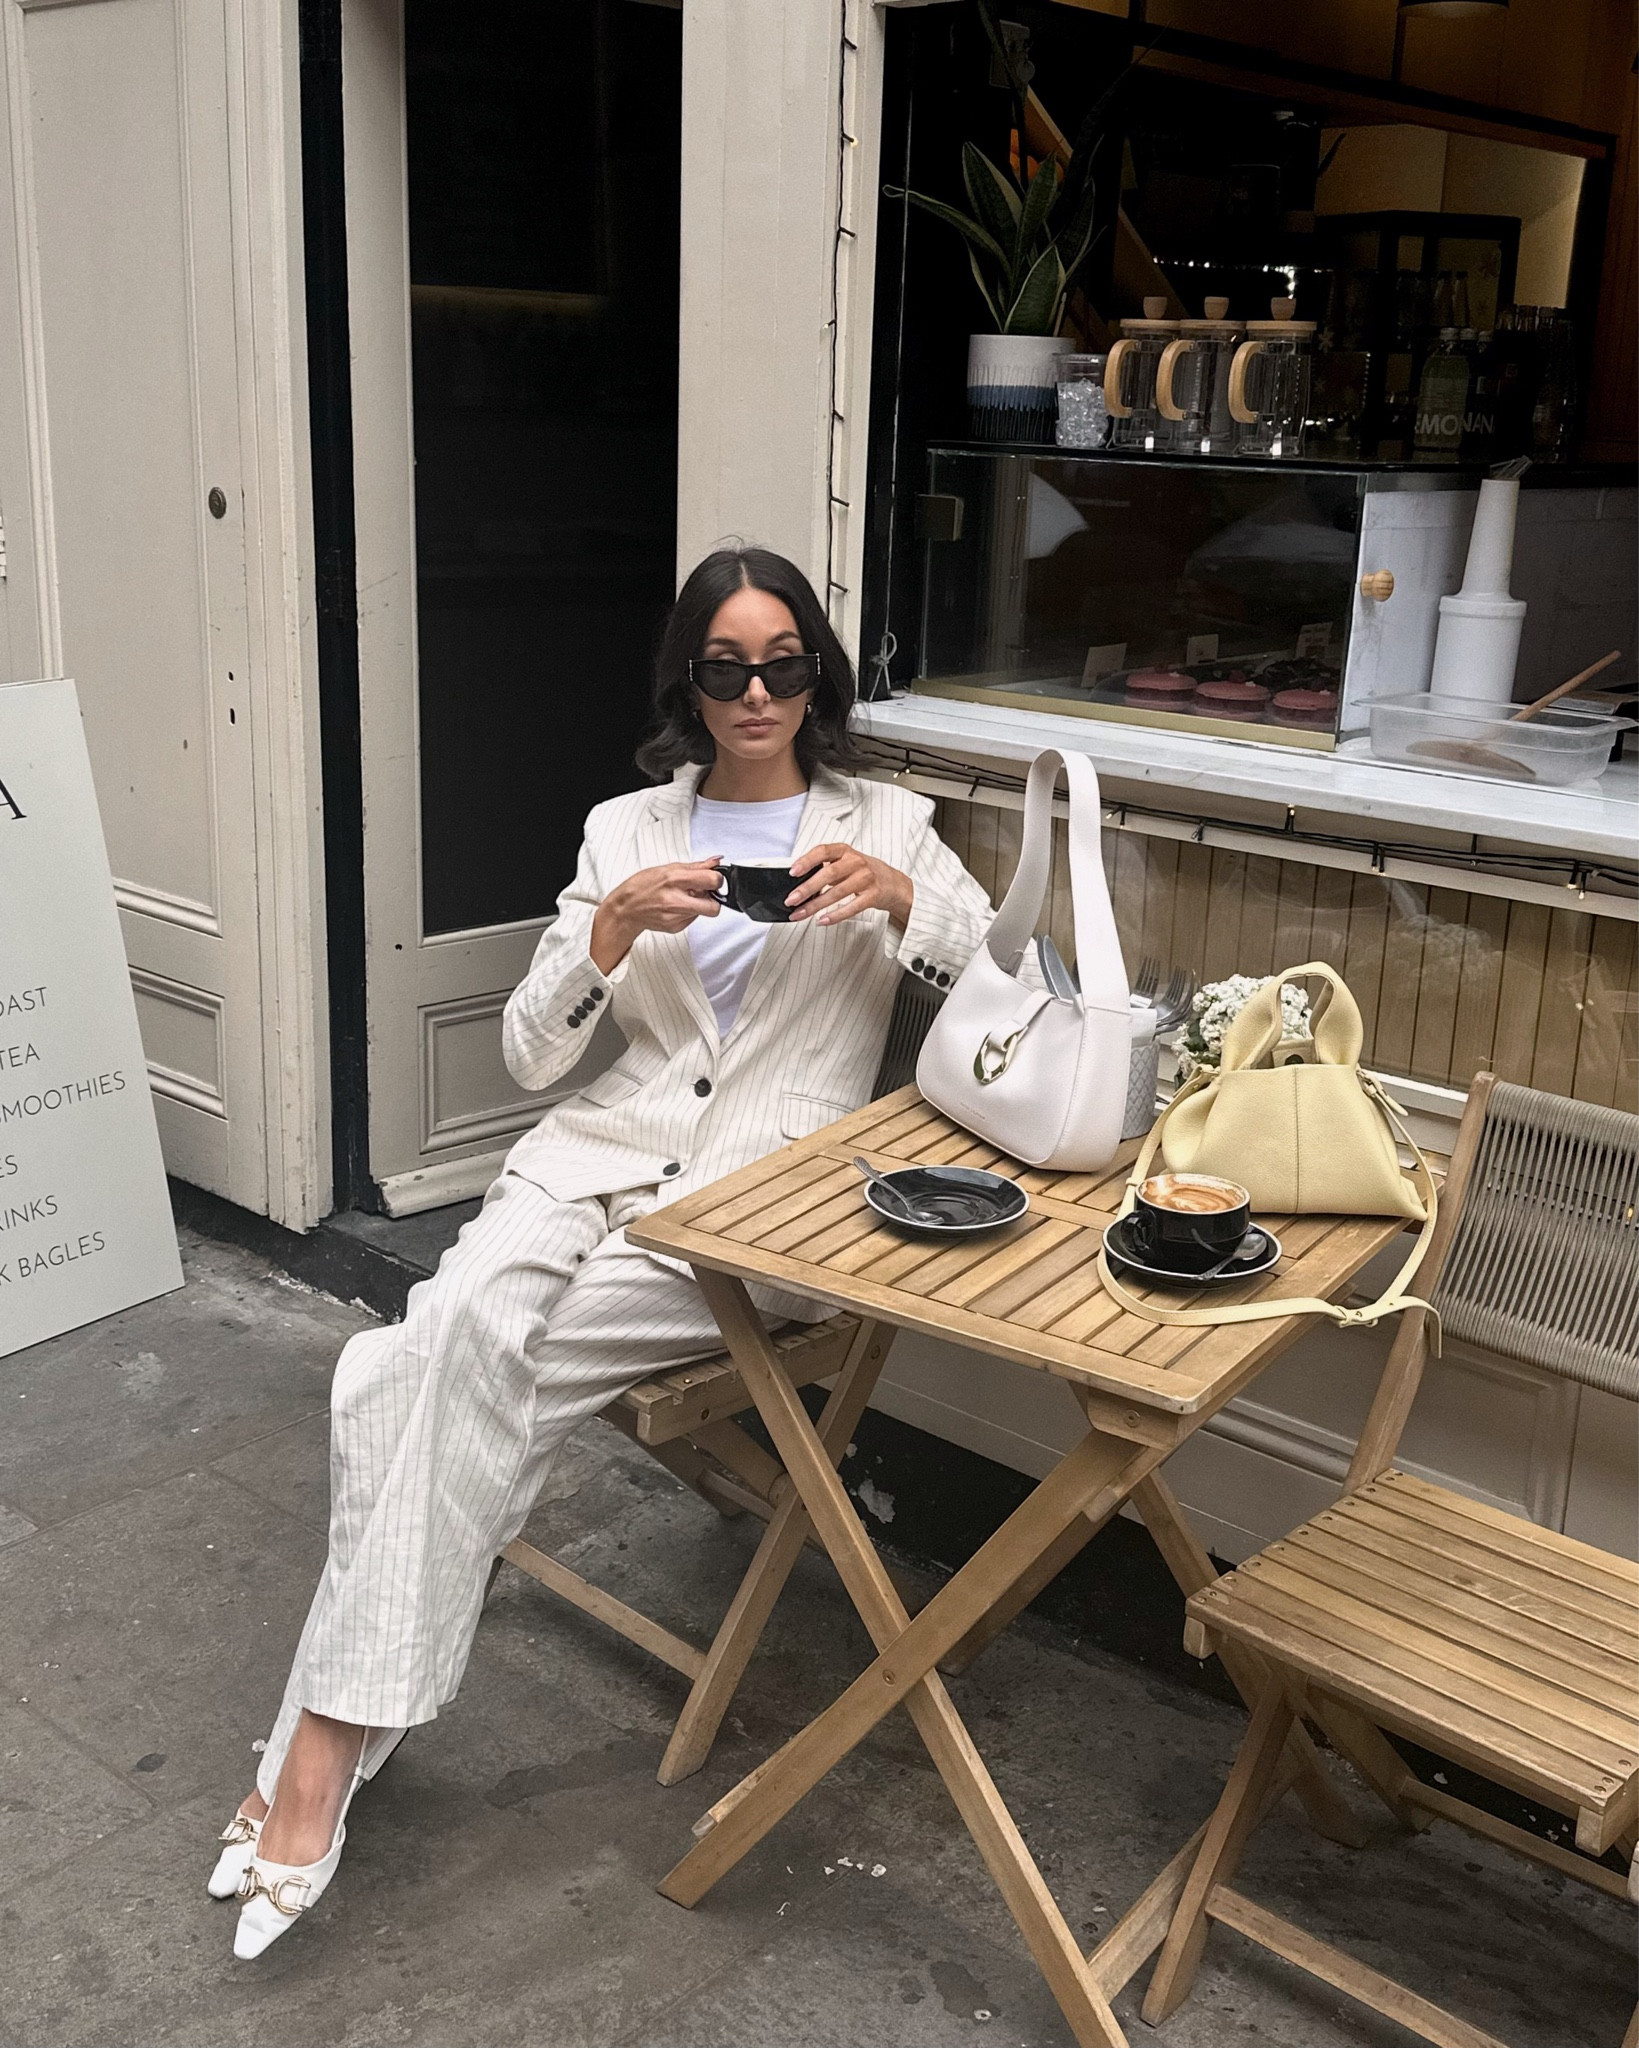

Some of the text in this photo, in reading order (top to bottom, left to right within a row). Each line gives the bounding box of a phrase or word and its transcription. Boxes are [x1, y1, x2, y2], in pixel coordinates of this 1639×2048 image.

[0, 986, 47, 1017] AST
[0, 1070, 126, 1123] MOOTHIES
[0, 1194, 58, 1231] INKS
[18, 1231, 105, 1278] BAGLES
